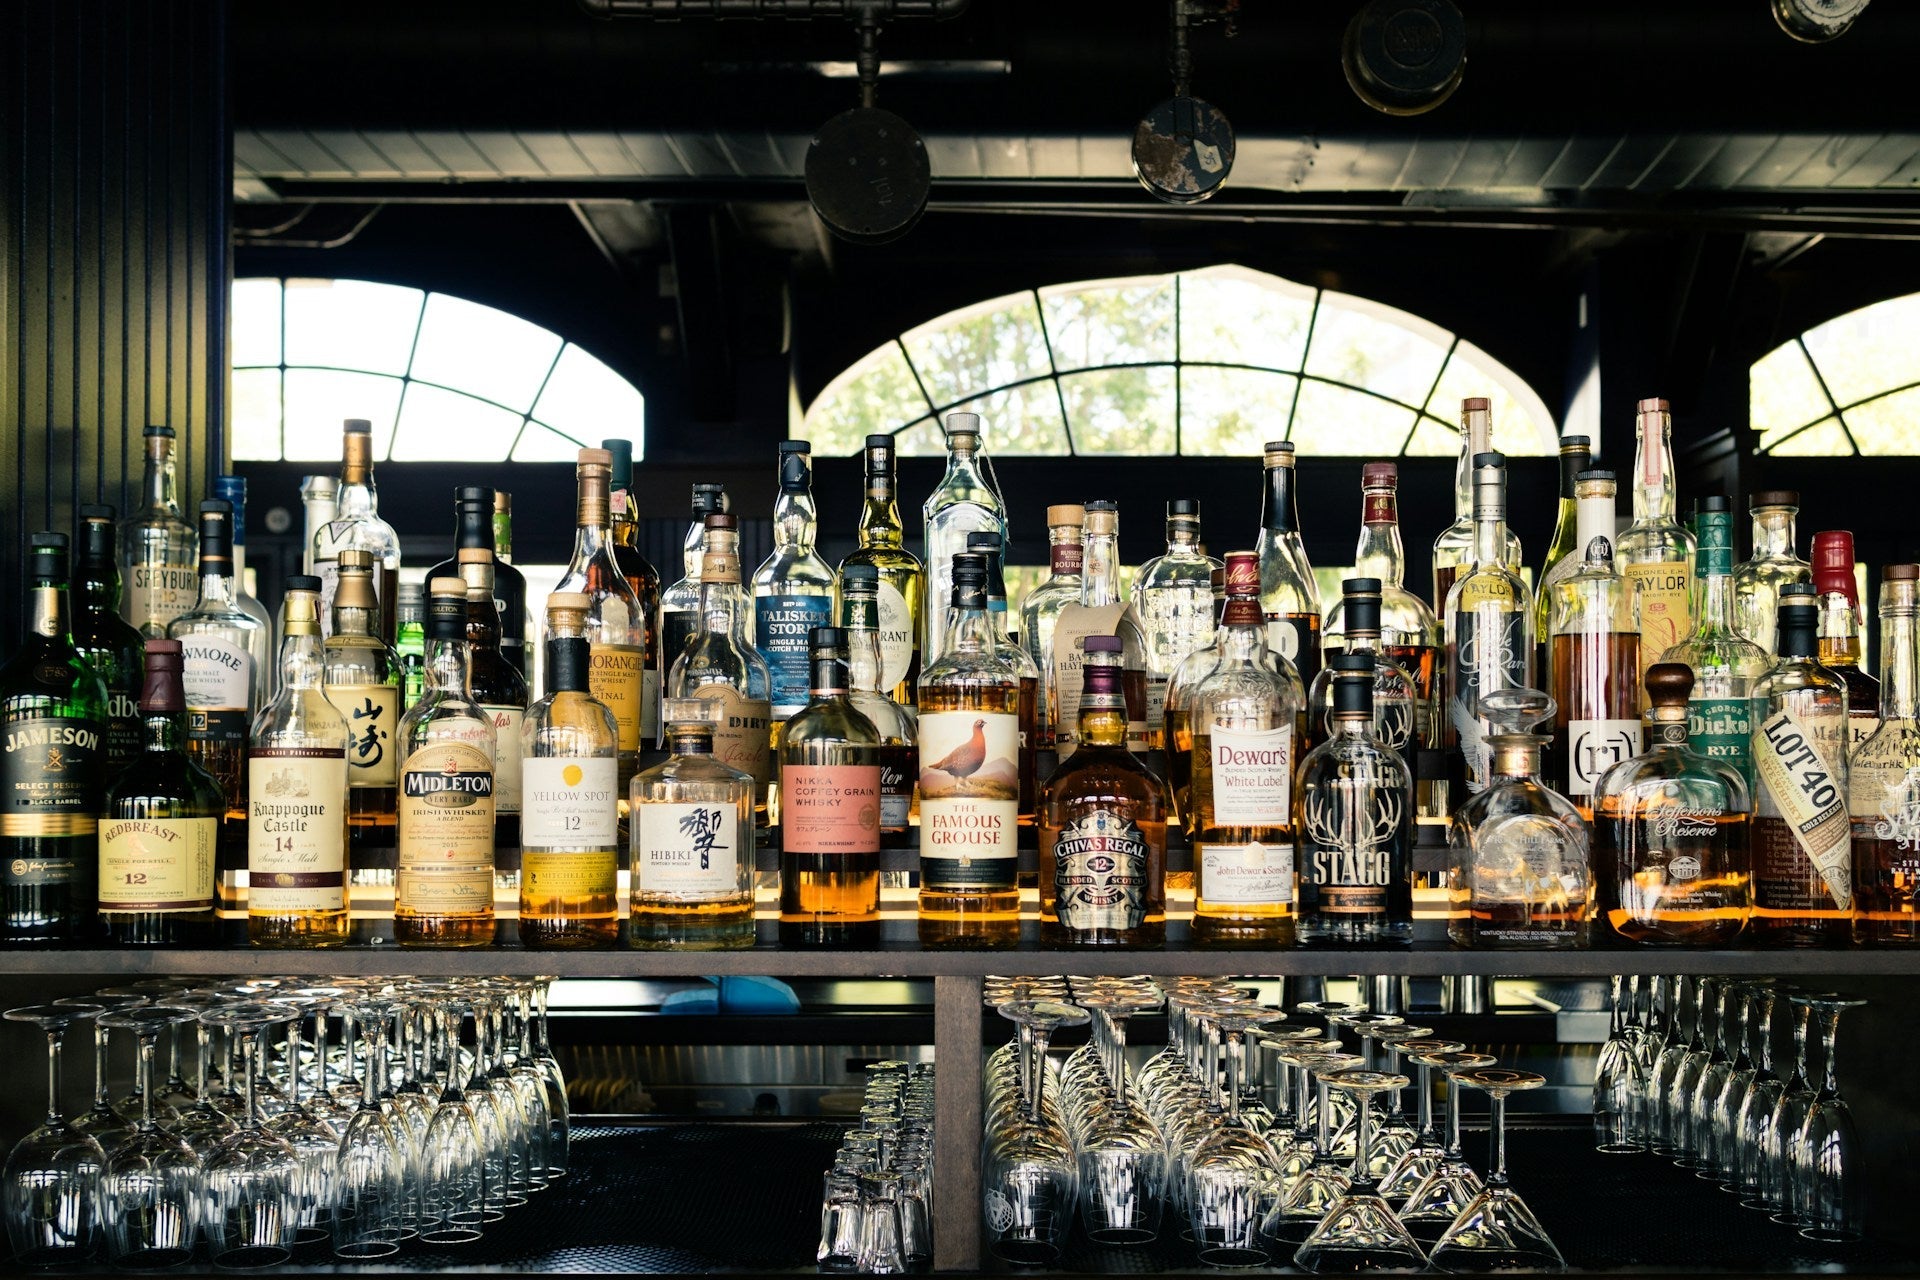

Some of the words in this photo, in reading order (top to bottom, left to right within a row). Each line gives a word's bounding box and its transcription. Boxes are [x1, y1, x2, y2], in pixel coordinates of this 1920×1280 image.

[1628, 568, 1666, 576] COLONEL
[1639, 576, 1686, 591] AYLOR
[761, 610, 826, 622] TALISKER
[880, 631, 908, 642] RANT
[183, 648, 242, 672] WMORE
[1704, 704, 1744, 716] GEORGE
[192, 716, 205, 728] 12
[6, 727, 98, 752] JAMESON
[1218, 746, 1287, 766] Dewar's
[1707, 746, 1740, 756] RYE
[1764, 715, 1817, 772] LOT
[1800, 769, 1836, 808] 40
[407, 772, 491, 794] MIDLETON
[795, 777, 832, 785] NIKKA
[533, 791, 580, 801] YELLOW
[584, 791, 611, 801] SPOT
[795, 788, 840, 796] COFFEY
[844, 788, 874, 796] GRAIN
[795, 798, 842, 806] WHISKY
[1772, 779, 1804, 823] WHISKY
[253, 801, 326, 818] Knappogue
[952, 804, 978, 812] THE
[264, 818, 308, 832] Castle
[564, 816, 580, 830] 12
[932, 814, 1002, 828] FAMOUS
[104, 822, 179, 844] REDBREAST
[1655, 818, 1718, 838] Reserve
[932, 830, 1001, 844] GROUSE
[275, 836, 293, 852] 14
[1056, 838, 1102, 858] CHIVAS
[1105, 839, 1145, 858] REGAL
[650, 850, 692, 860] HIBIKI
[1094, 858, 1107, 870] 12
[1237, 866, 1262, 875] Dewar
[1313, 851, 1390, 886] STAGG
[125, 872, 147, 885] 12
[1058, 876, 1093, 885] BLENDED
[1111, 876, 1144, 885] SCOTCH
[1084, 894, 1118, 904] WHISKY
